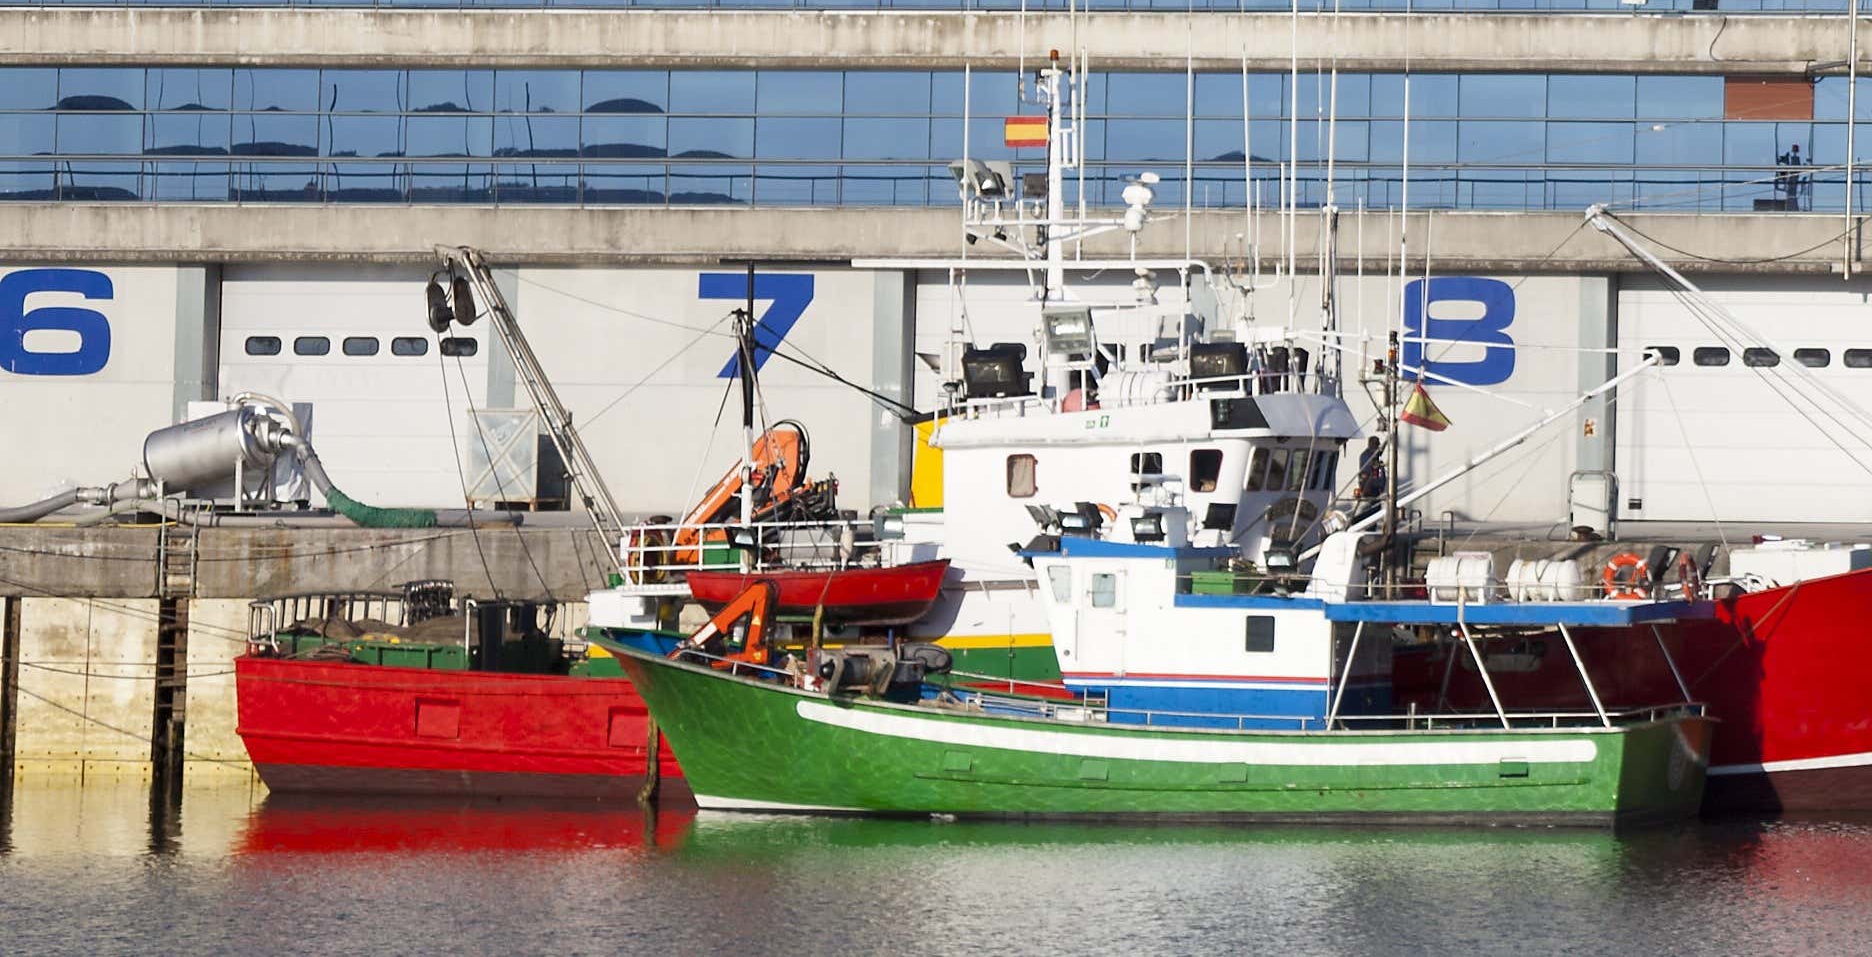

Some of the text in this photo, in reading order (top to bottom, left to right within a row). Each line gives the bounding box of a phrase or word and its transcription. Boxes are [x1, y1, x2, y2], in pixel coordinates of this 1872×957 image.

[0, 268, 114, 376] 6
[698, 272, 815, 378] 7
[1399, 276, 1516, 385] 8
